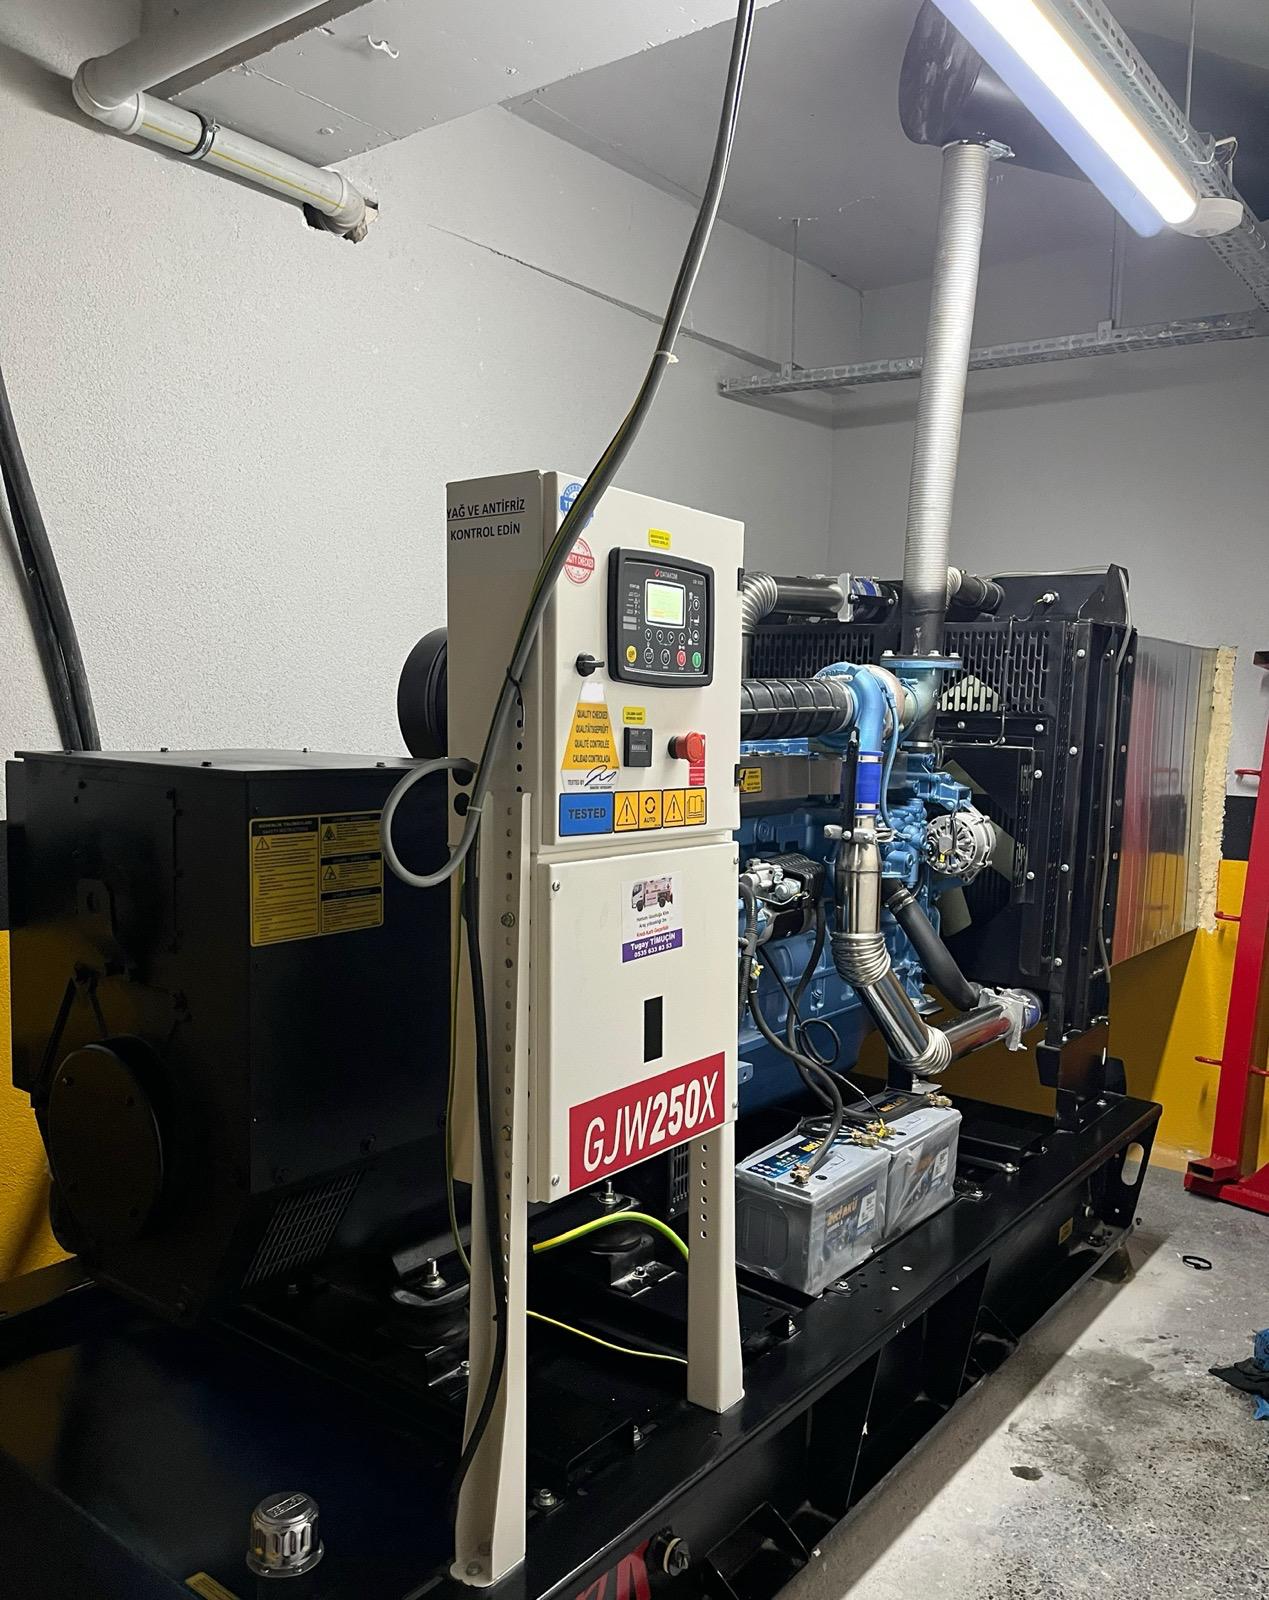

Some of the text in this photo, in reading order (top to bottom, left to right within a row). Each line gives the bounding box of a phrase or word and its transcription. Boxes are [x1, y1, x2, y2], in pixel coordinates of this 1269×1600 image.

[447, 497, 526, 518] YAĞ VE ANTİFRİZ
[450, 521, 521, 541] KONTROL EDİN
[568, 807, 607, 820] TESTED
[630, 940, 650, 951] Tugay
[583, 1071, 719, 1172] GJW250X
